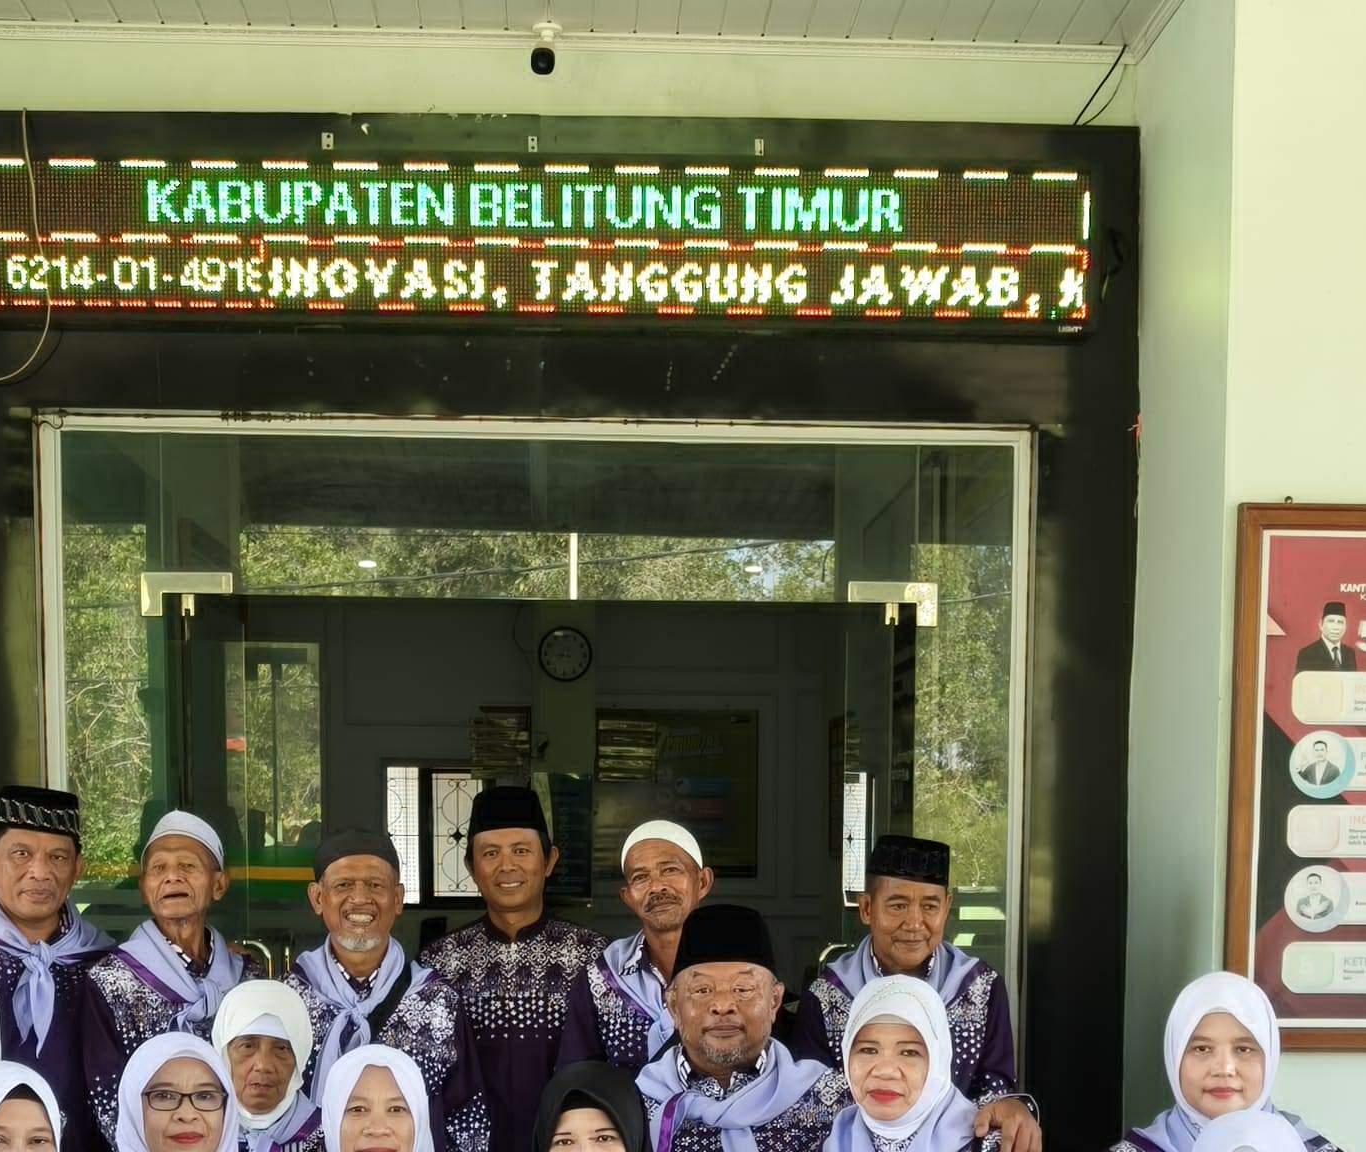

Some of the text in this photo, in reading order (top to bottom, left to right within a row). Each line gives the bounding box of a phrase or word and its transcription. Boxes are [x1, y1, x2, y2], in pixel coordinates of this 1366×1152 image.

[146, 178, 903, 234] KABUPATEN BELITUNG TIMUR
[530, 259, 808, 305] TANGGUNG
[830, 263, 1041, 318] JAWAB,
